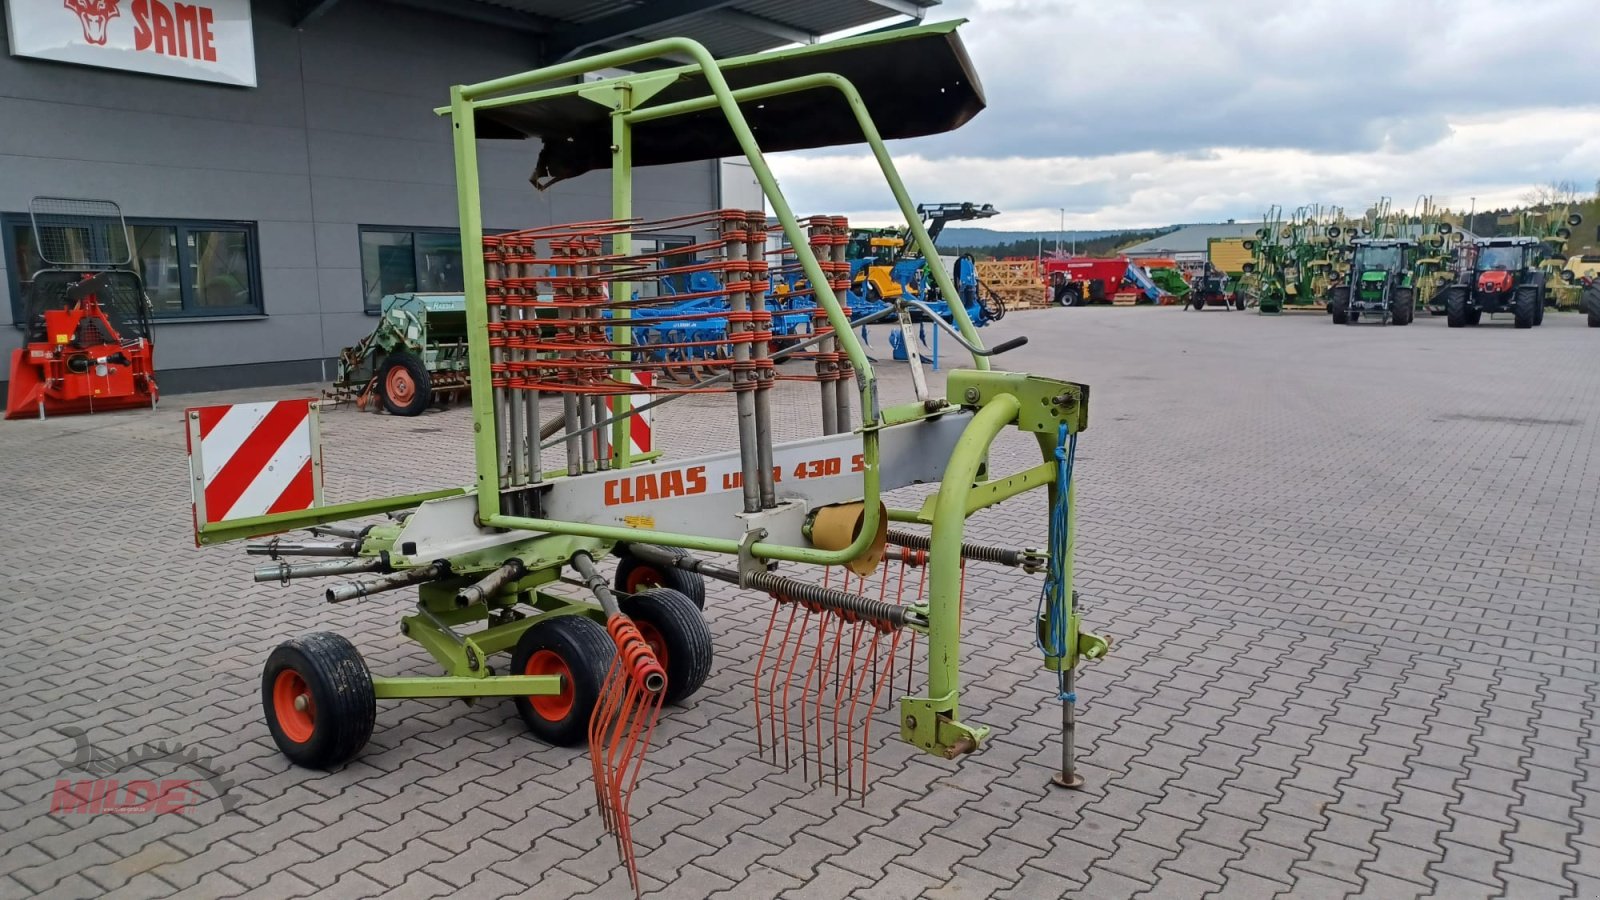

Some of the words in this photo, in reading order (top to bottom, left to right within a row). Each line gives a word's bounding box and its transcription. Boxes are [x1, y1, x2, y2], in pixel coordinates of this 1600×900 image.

[131, 0, 217, 62] SAME
[604, 465, 706, 507] CLAAS
[793, 456, 842, 480] 430
